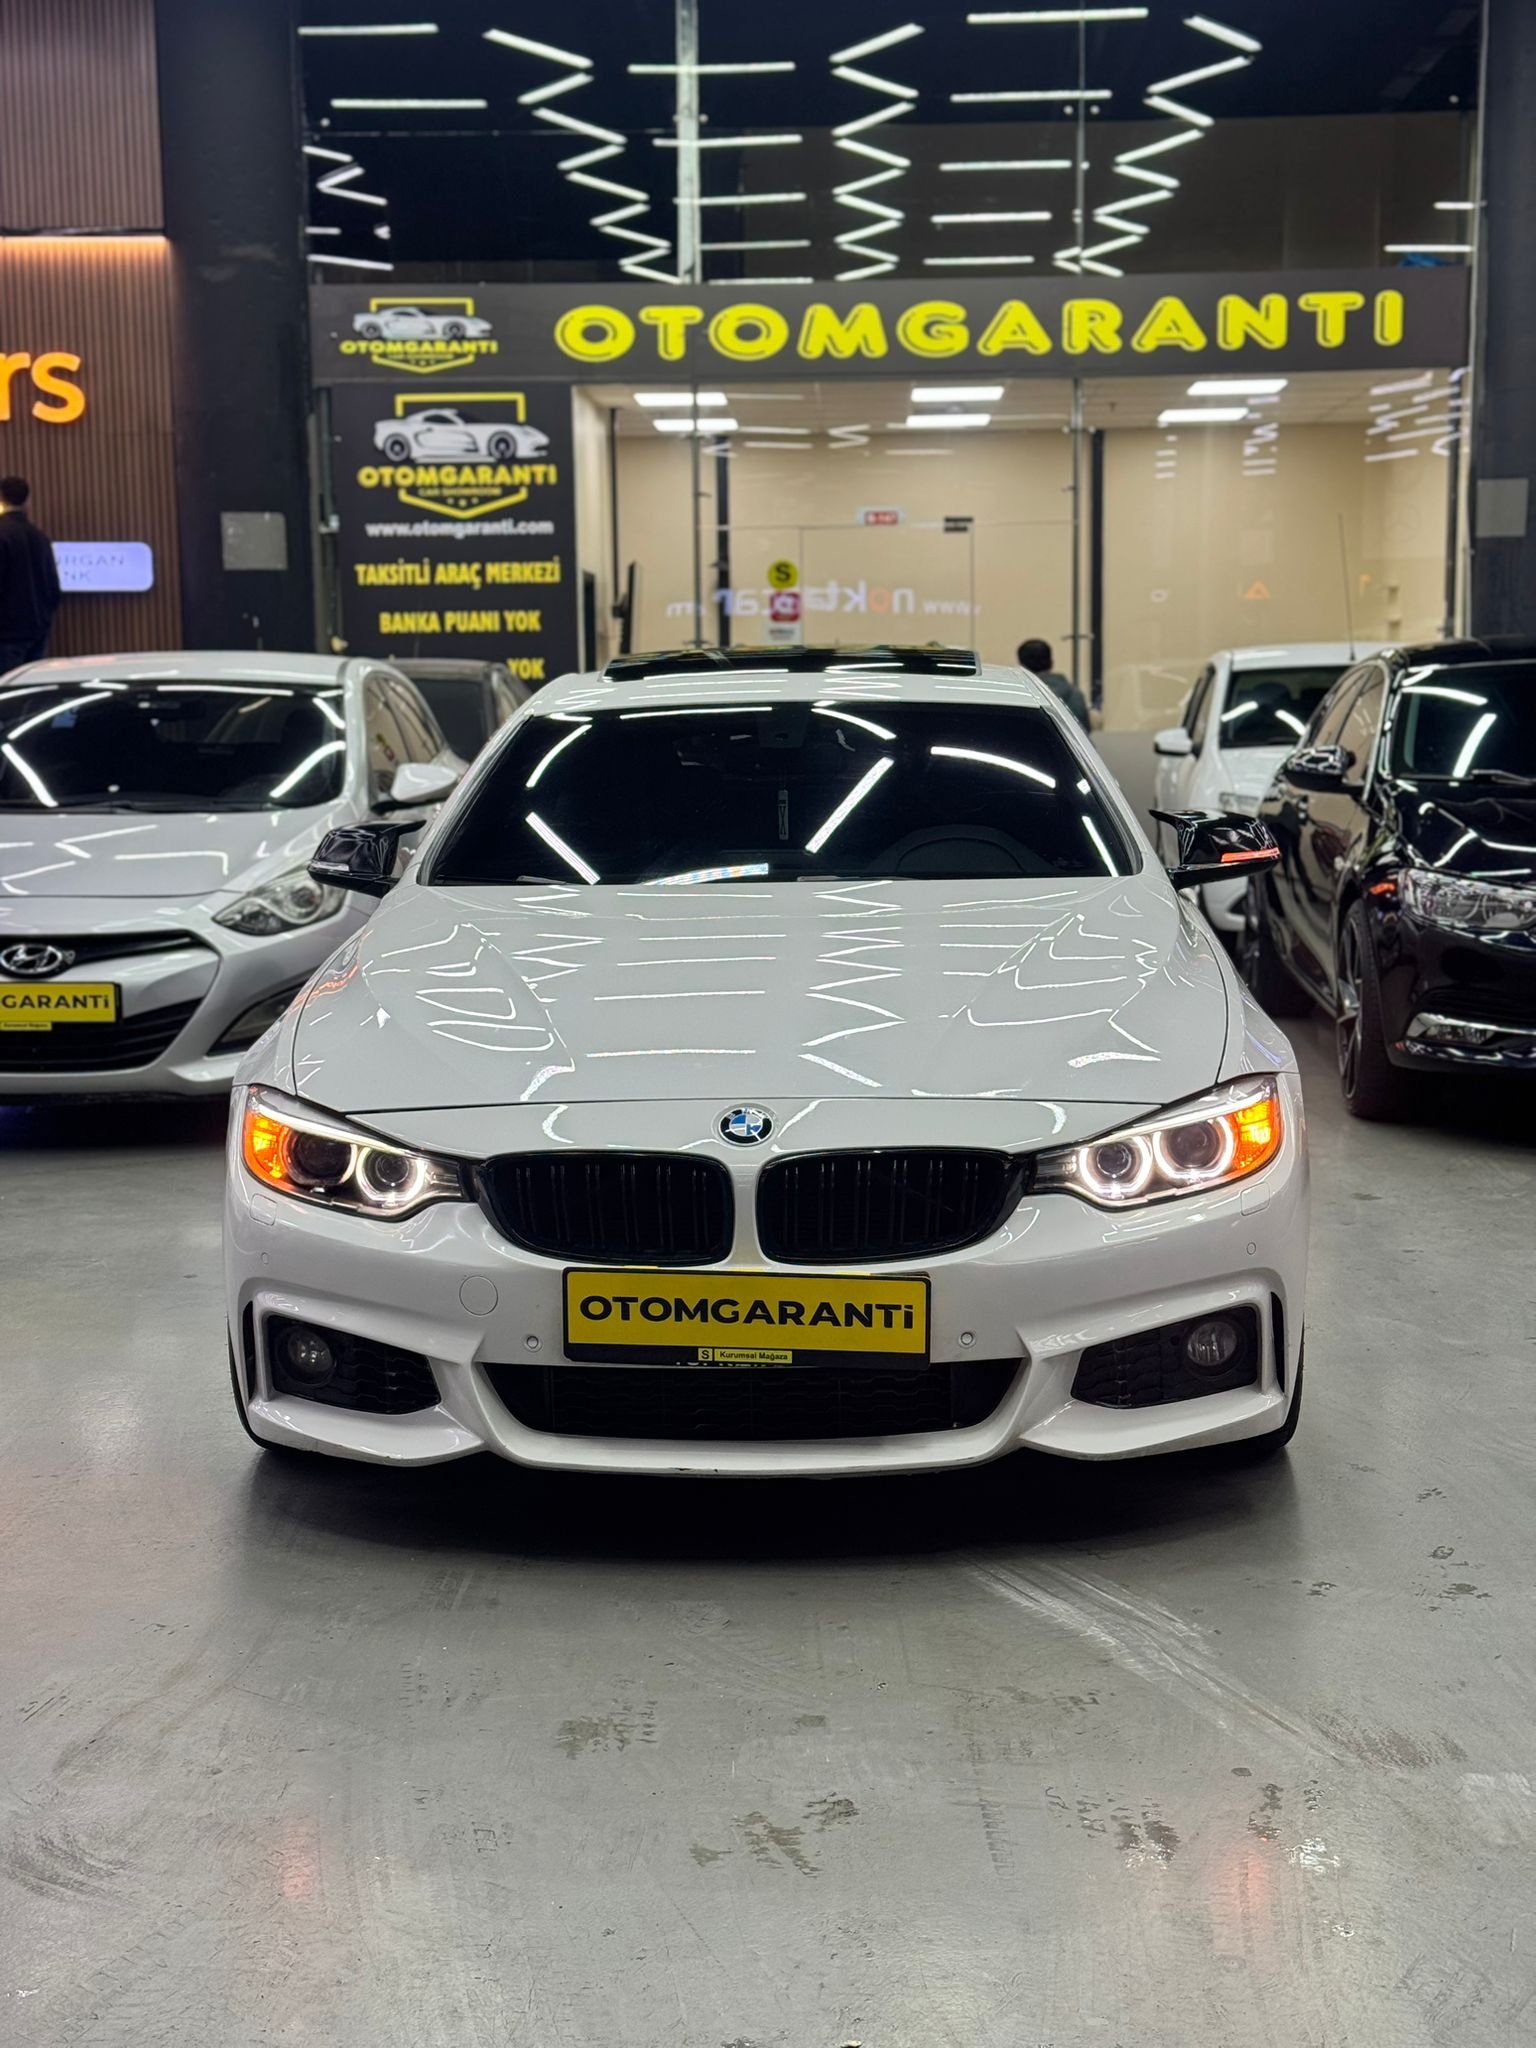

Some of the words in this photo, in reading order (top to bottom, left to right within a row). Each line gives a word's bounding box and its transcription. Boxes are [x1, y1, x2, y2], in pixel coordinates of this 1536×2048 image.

[554, 289, 1404, 363] OTOMGARANTI
[340, 339, 498, 355] OTOMGARANTI
[357, 464, 558, 488] OTOMGARANTI
[365, 519, 555, 539] www.otomgaranti.com
[354, 558, 431, 585] TAKSİTLİ
[434, 562, 482, 590] ARAÇ
[485, 555, 561, 584] MERKEZİ
[379, 612, 440, 634] BANKA
[444, 610, 501, 633] PUANI
[503, 610, 541, 632] YOK
[506, 658, 545, 680] YOK
[580, 1295, 914, 1329] OTOMGARANTi
[701, 1349, 711, 1360] S
[719, 1351, 757, 1360] Kurumsal
[758, 1352, 788, 1362] Mağaza
